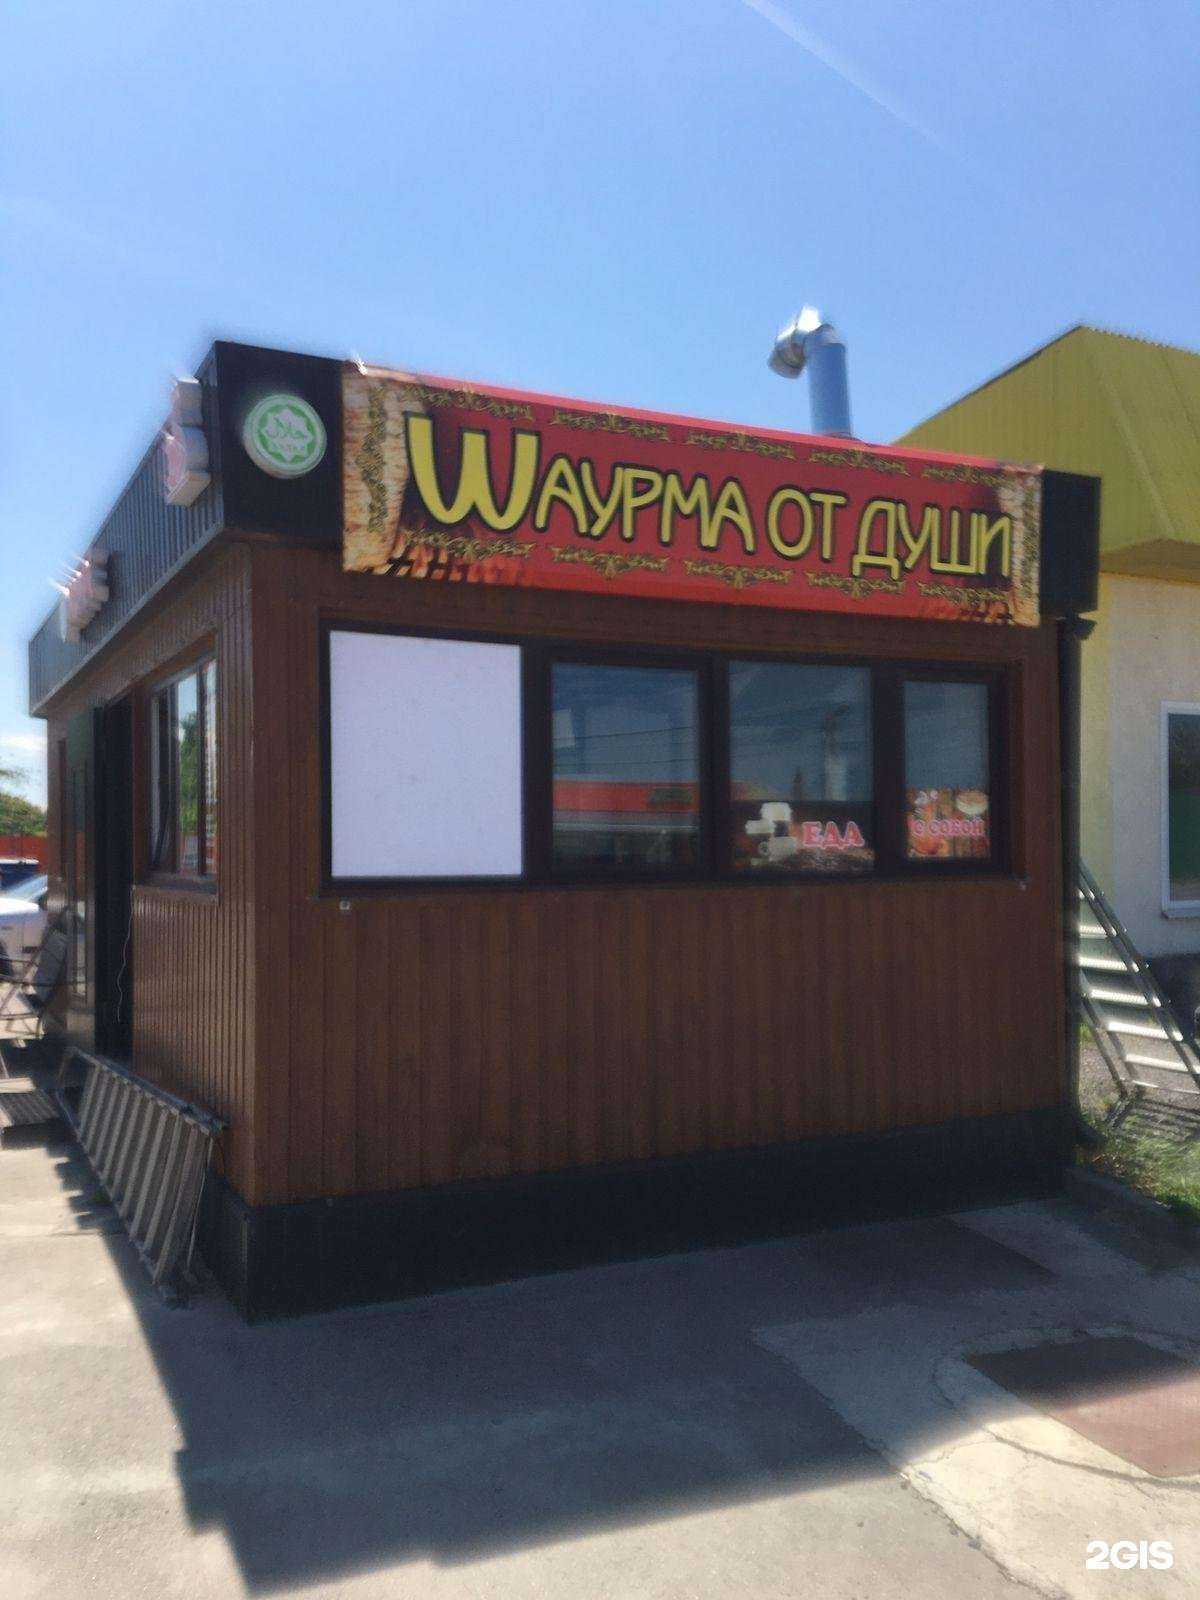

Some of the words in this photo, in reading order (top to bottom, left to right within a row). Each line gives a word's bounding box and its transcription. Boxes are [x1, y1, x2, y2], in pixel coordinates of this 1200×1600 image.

[402, 411, 755, 554] ШАУРМА
[767, 488, 847, 560] ОТ
[853, 499, 1012, 581] ДУШИ
